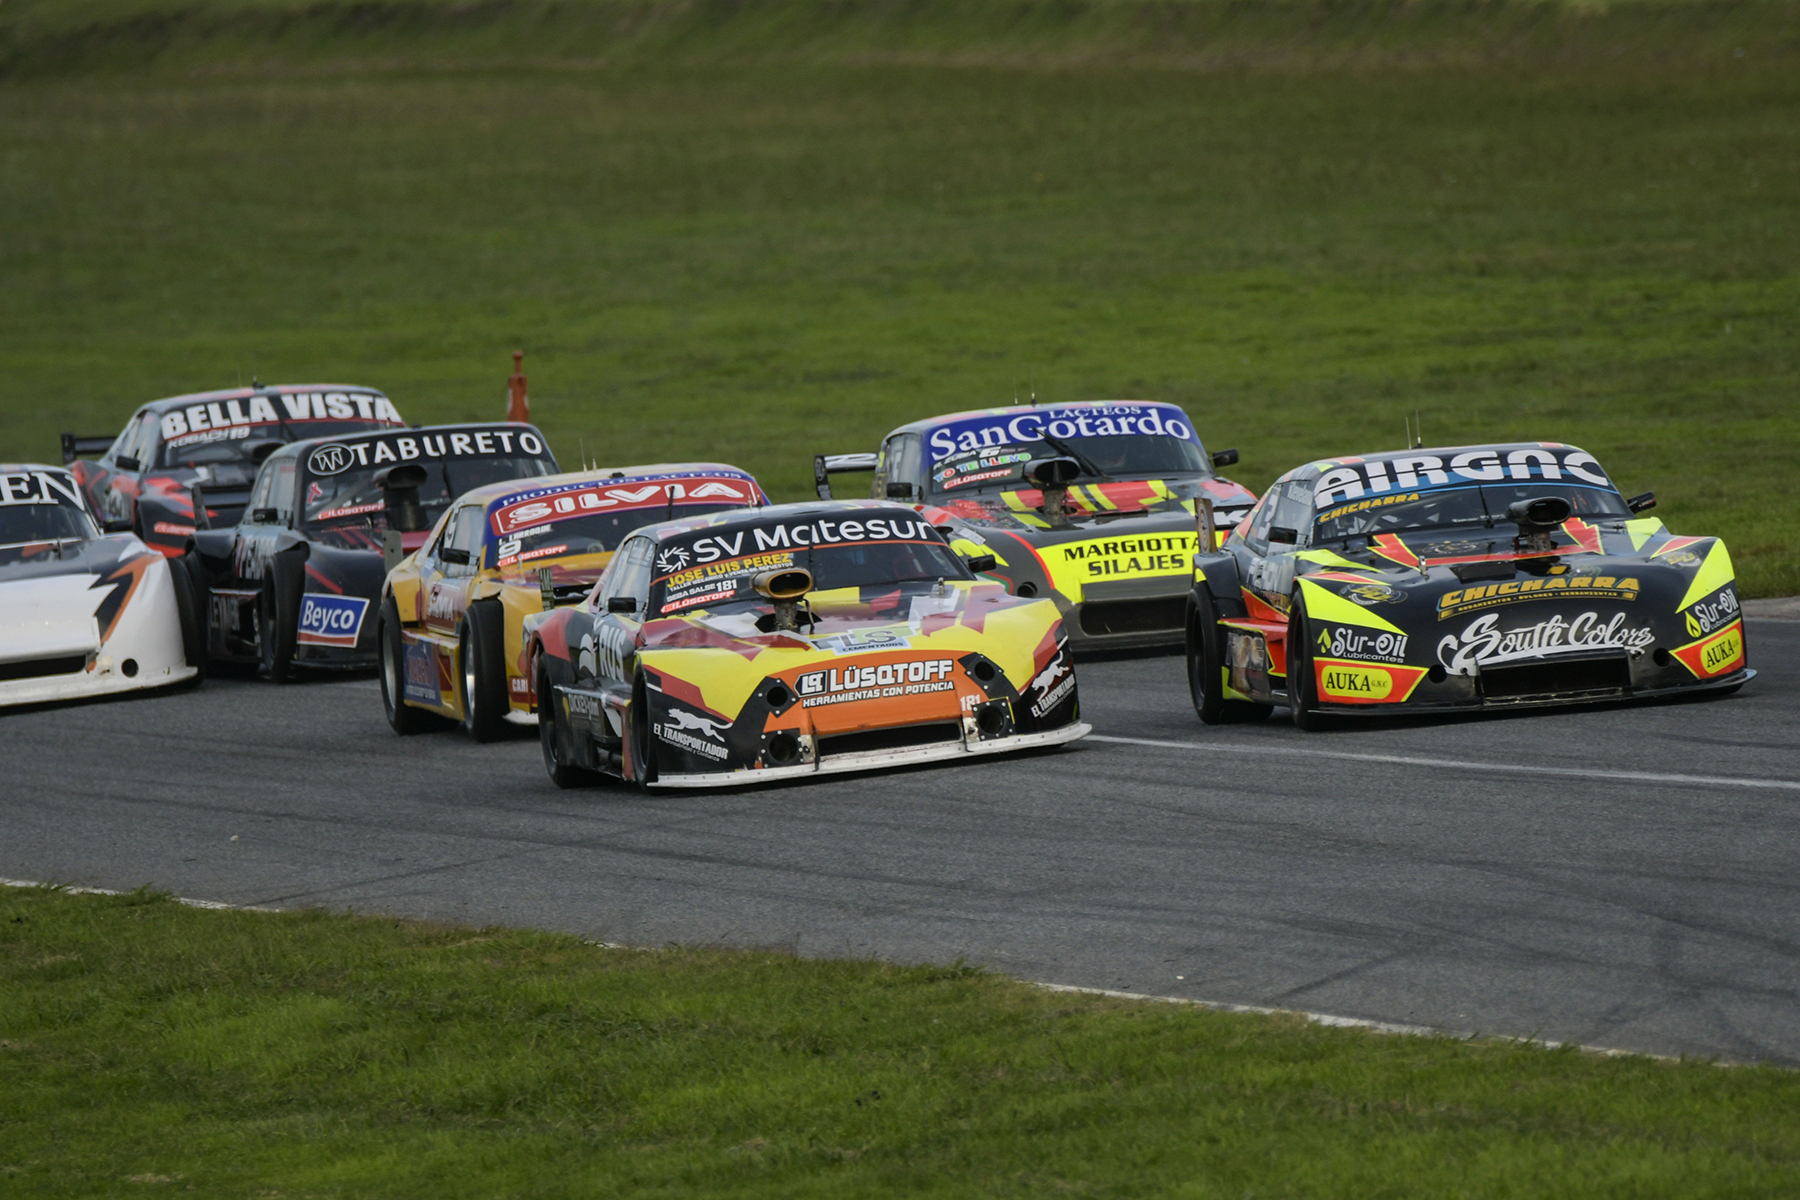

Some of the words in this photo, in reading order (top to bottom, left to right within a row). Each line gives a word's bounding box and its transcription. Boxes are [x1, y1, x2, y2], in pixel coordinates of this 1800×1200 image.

[160, 396, 279, 440] BELLA
[281, 392, 403, 424] VISTA
[1049, 406, 1141, 419] LACTEOS
[350, 431, 543, 466] TABURETO
[933, 467, 956, 483] YO
[956, 461, 979, 473] TE
[980, 452, 1032, 468] LLEVO
[508, 482, 744, 525] SILVIA
[1319, 492, 1420, 523] CHICHARRA
[498, 539, 522, 559] 9
[693, 531, 744, 563] SV
[753, 518, 934, 551] Matesur
[667, 569, 704, 588] JOSE
[706, 560, 741, 576] LUIS
[743, 552, 792, 569] PEREZ
[1088, 553, 1185, 576] SILAJES
[670, 581, 692, 592] TALLER
[729, 568, 751, 578] VENTA
[716, 579, 738, 592] 181
[1439, 576, 1640, 609] CHICHARRA
[302, 600, 356, 633] Beyco
[1458, 597, 1512, 612] RODAMIENTOS
[842, 642, 904, 652] CEMENTADOS
[1343, 651, 1404, 664] Lubricantes
[1437, 613, 1569, 676] South
[1567, 612, 1656, 650] Colors
[1706, 638, 1735, 668] AUKA
[802, 689, 881, 709] HERRAMIENTAS
[882, 685, 904, 697] CON
[904, 680, 955, 694] POTENCIA
[1325, 671, 1372, 692] AUKA
[959, 694, 981, 712] 181
[653, 723, 662, 736] EL
[664, 726, 729, 760] TRANSPORTADOR
